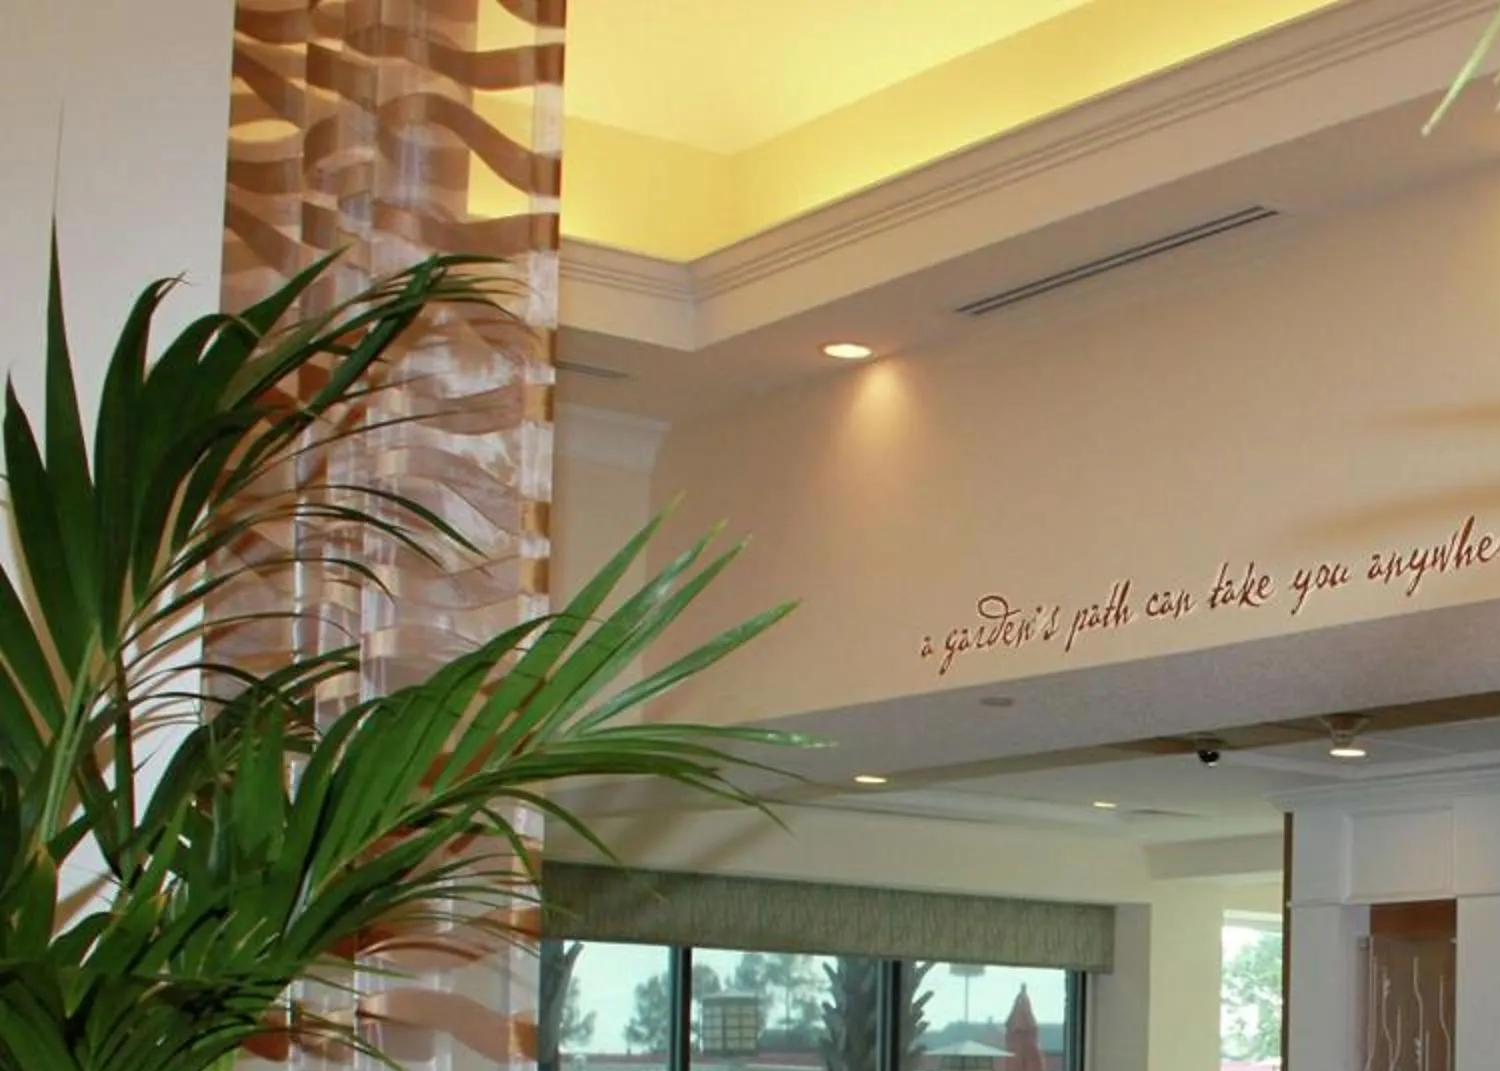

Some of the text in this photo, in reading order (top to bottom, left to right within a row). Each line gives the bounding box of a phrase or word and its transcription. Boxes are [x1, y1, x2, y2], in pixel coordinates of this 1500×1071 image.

[920, 635, 934, 658] a
[938, 595, 1062, 675] garden's
[1064, 579, 1133, 652] path
[1145, 590, 1194, 619] can
[1208, 561, 1276, 609] take
[1288, 562, 1351, 615] you
